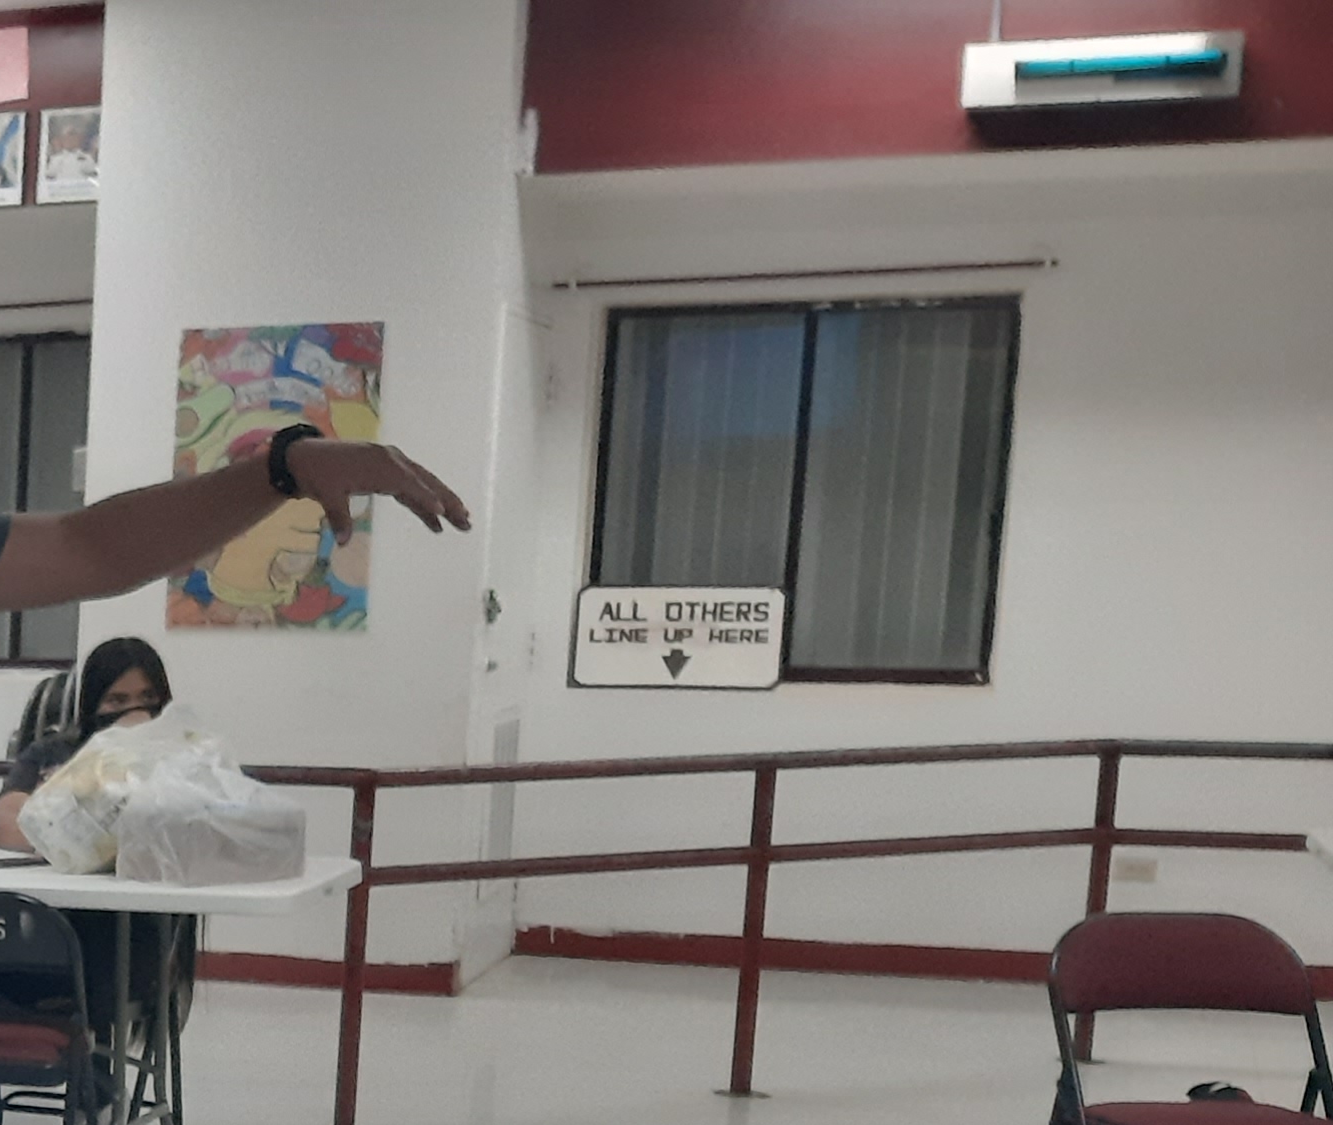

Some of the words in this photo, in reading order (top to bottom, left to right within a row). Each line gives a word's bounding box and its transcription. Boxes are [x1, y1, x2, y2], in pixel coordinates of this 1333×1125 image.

[599, 601, 648, 622] ALL
[665, 601, 770, 623] OTHERS
[589, 627, 648, 643] LINE
[664, 627, 694, 643] UP
[708, 627, 770, 644] HERE
